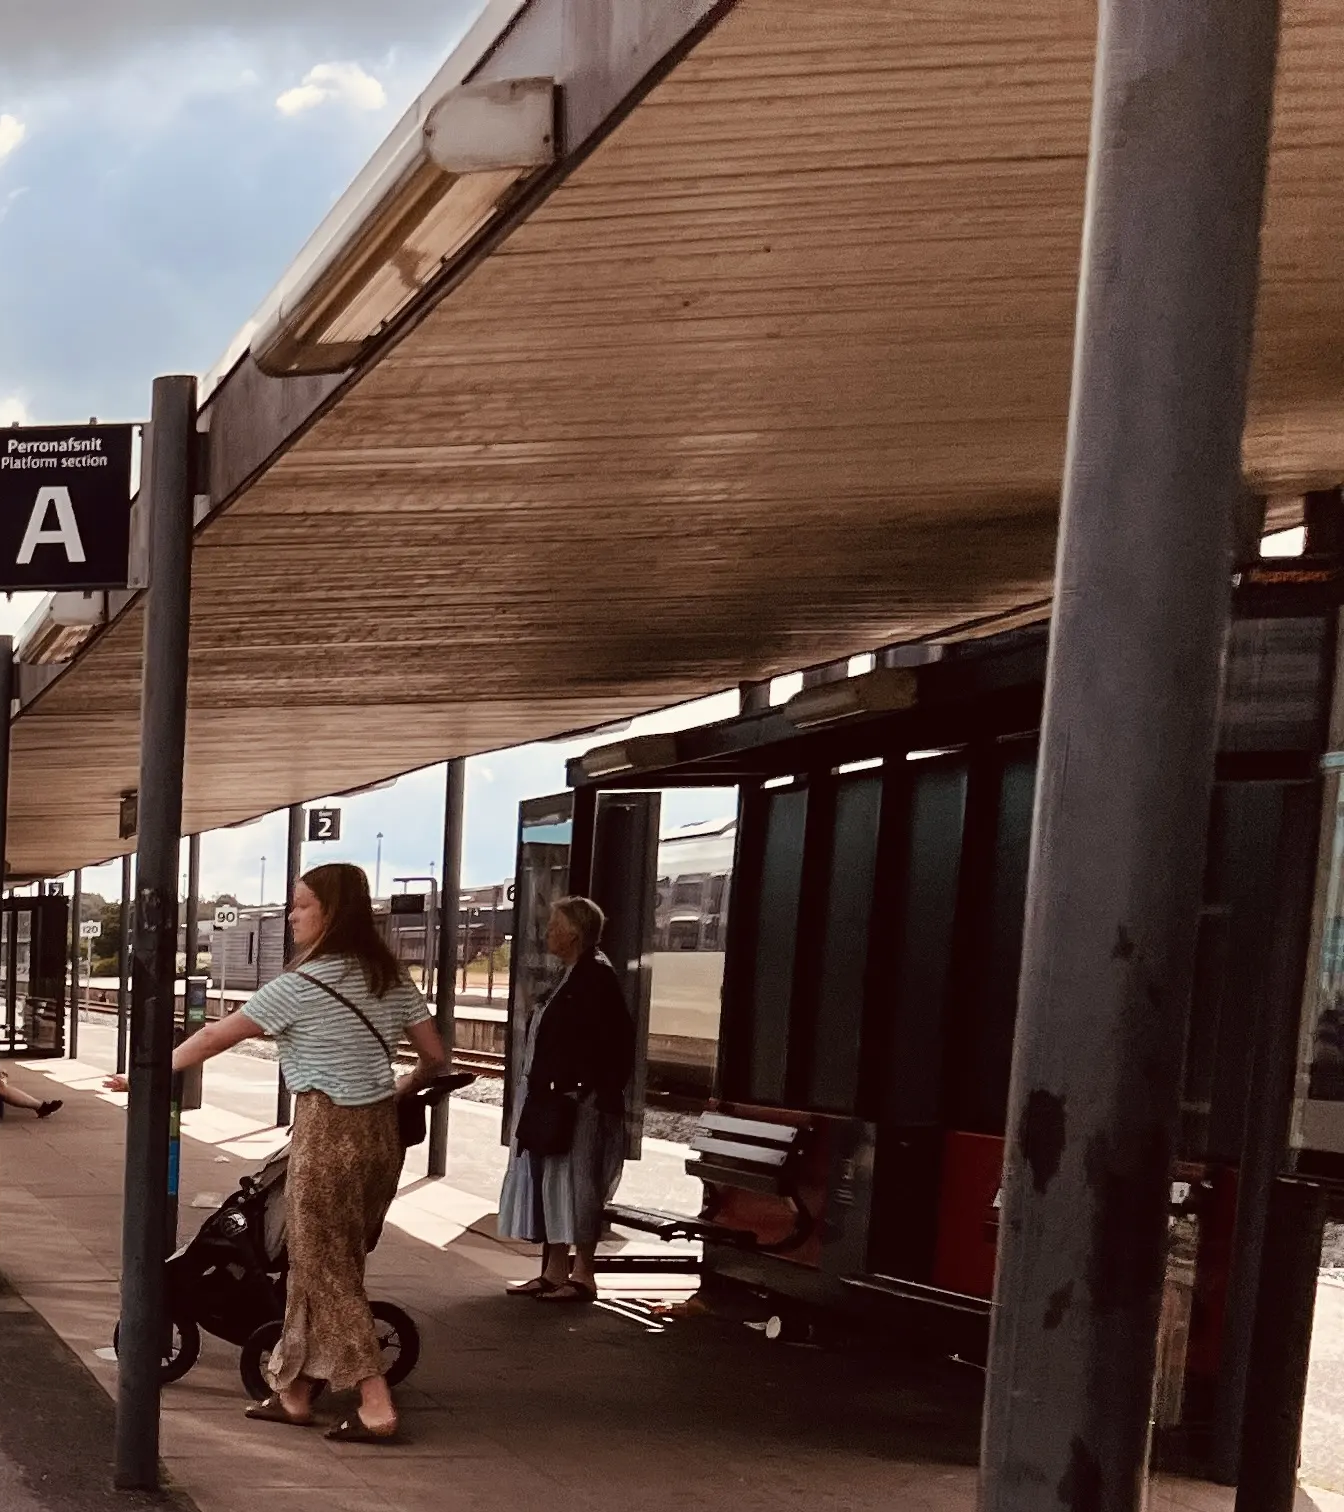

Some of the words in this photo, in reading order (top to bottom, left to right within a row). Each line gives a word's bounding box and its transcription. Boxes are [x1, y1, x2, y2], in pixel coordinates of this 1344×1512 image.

[8, 437, 102, 453] Perronafsnit
[1, 456, 57, 469] Platform
[61, 455, 108, 468] section
[15, 486, 87, 565] A
[318, 817, 332, 837] 2
[217, 911, 235, 923] 90
[82, 925, 98, 934] 120
